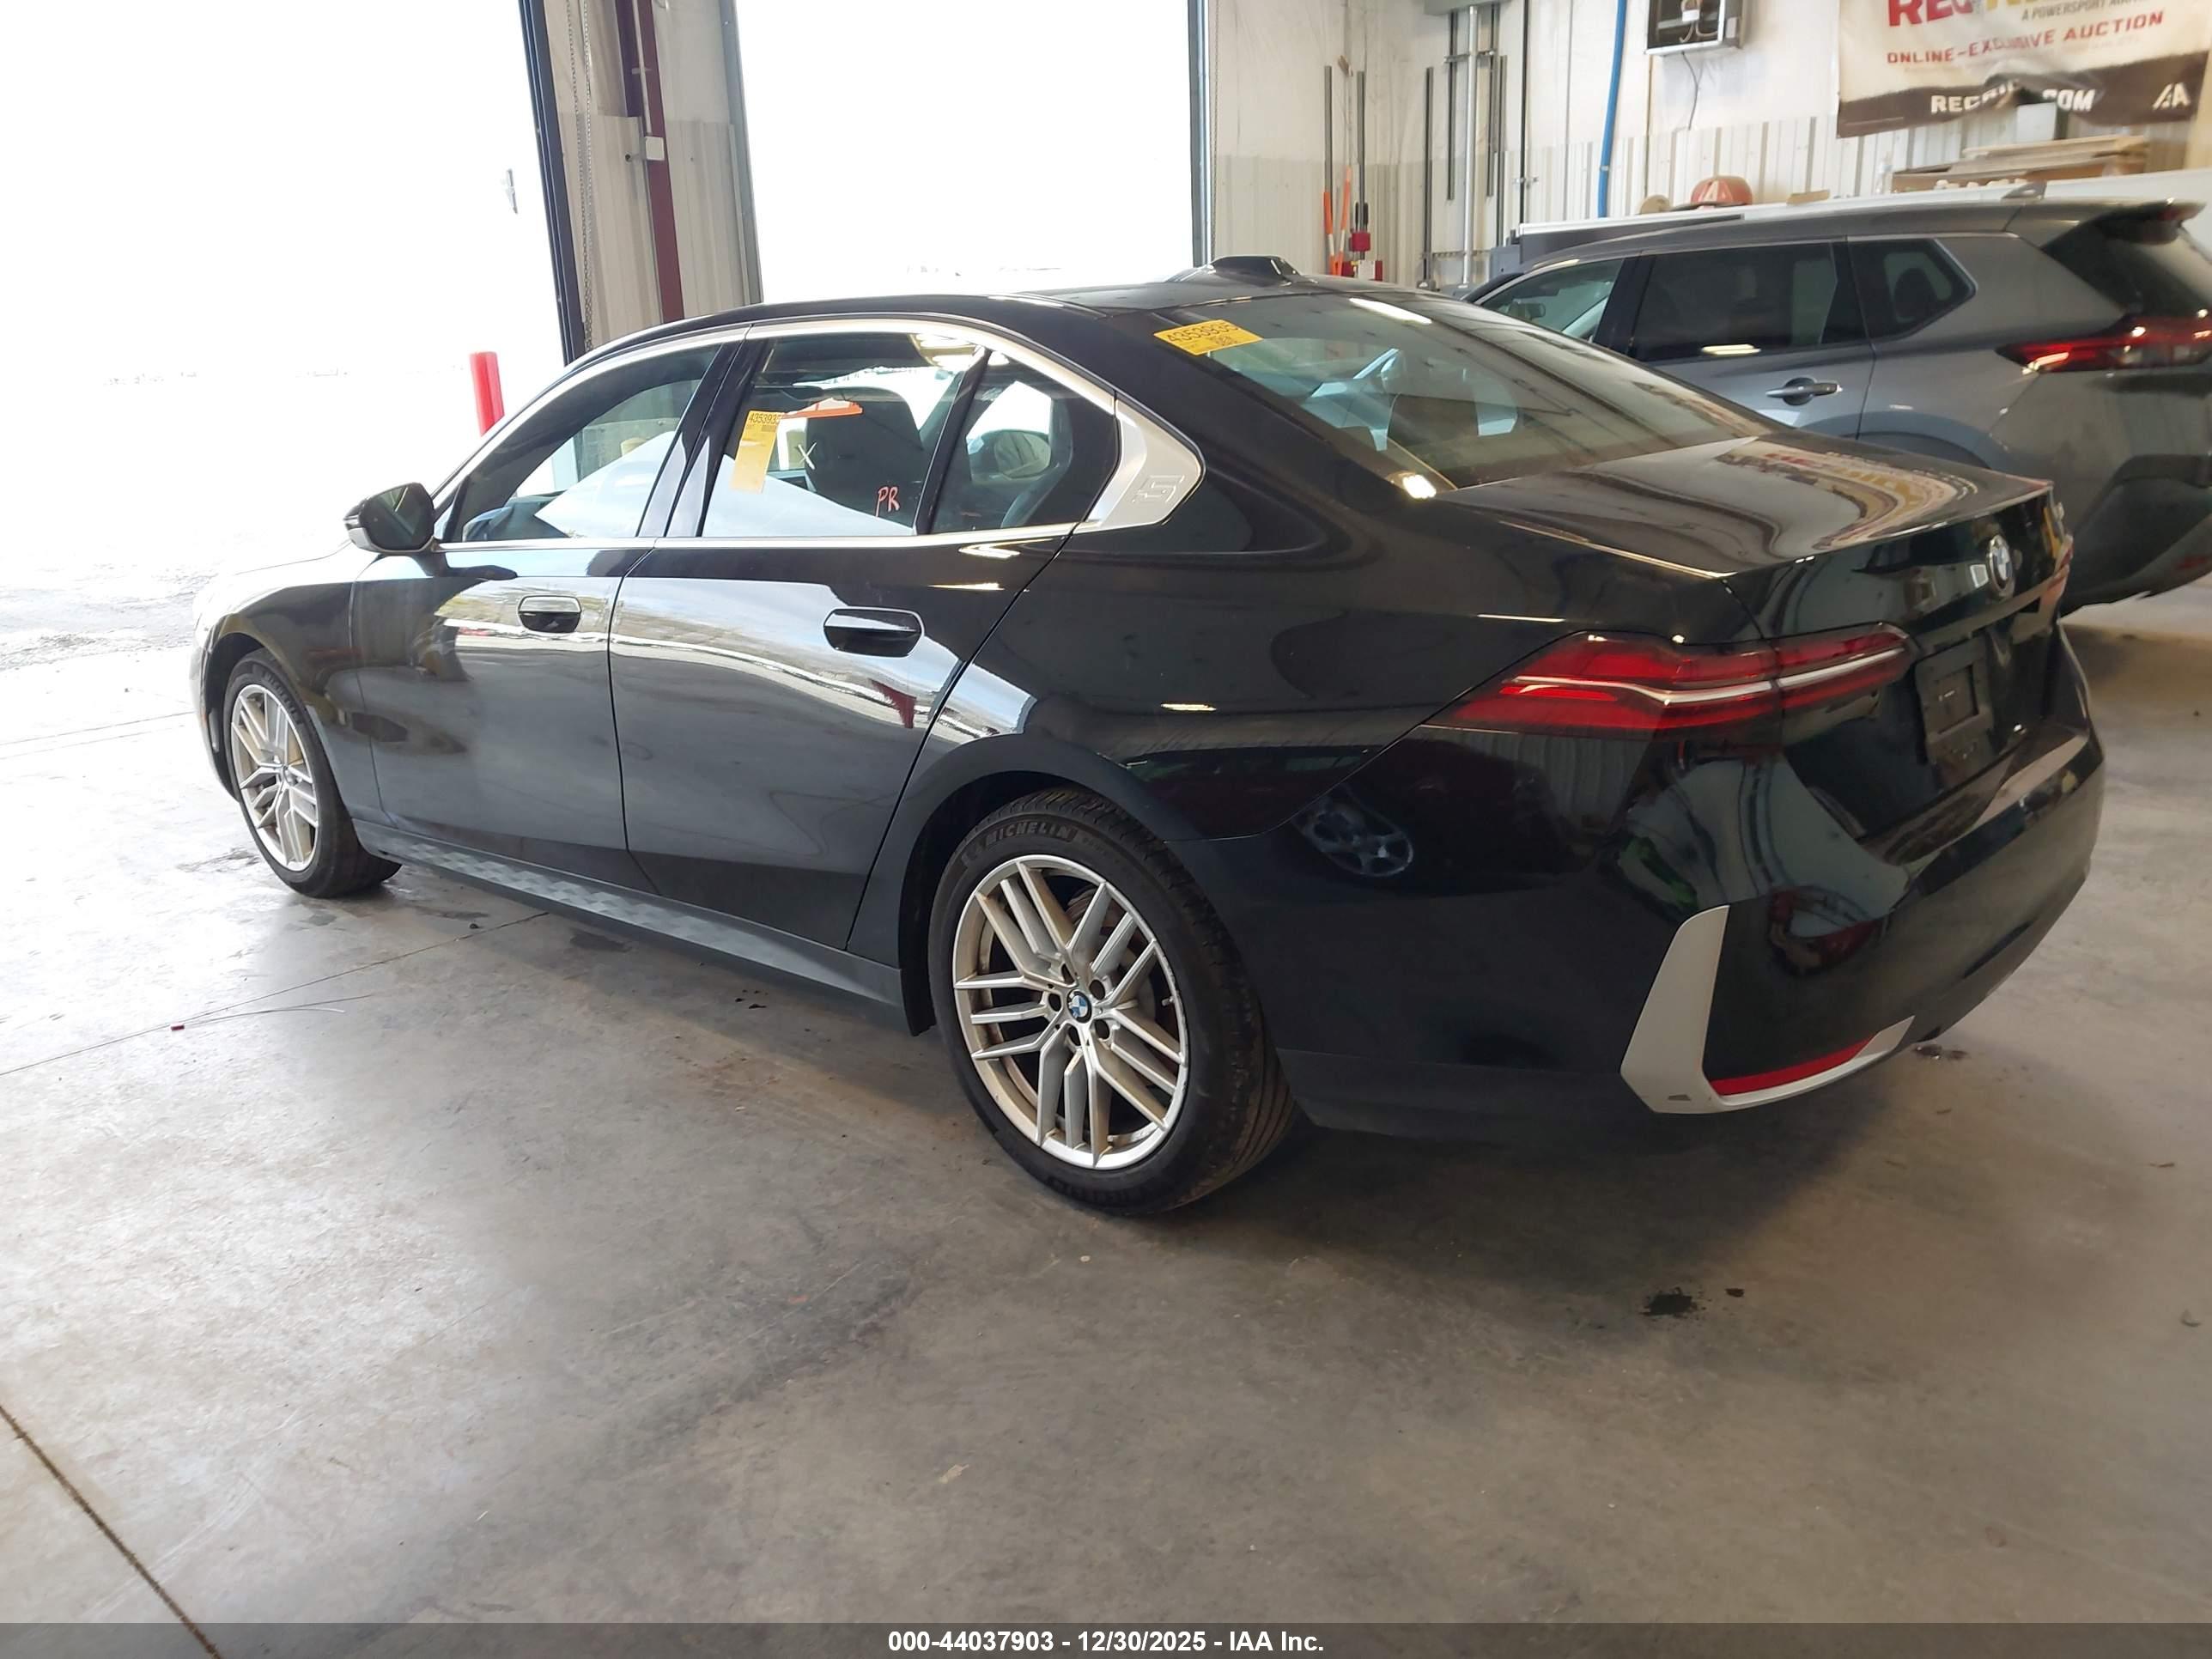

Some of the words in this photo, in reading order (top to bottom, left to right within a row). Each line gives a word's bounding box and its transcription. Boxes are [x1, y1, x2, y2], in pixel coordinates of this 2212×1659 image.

[2063, 10, 2163, 42] AUCTION
[876, 486, 900, 517] PR
[986, 821, 1072, 845] MICHELIN
